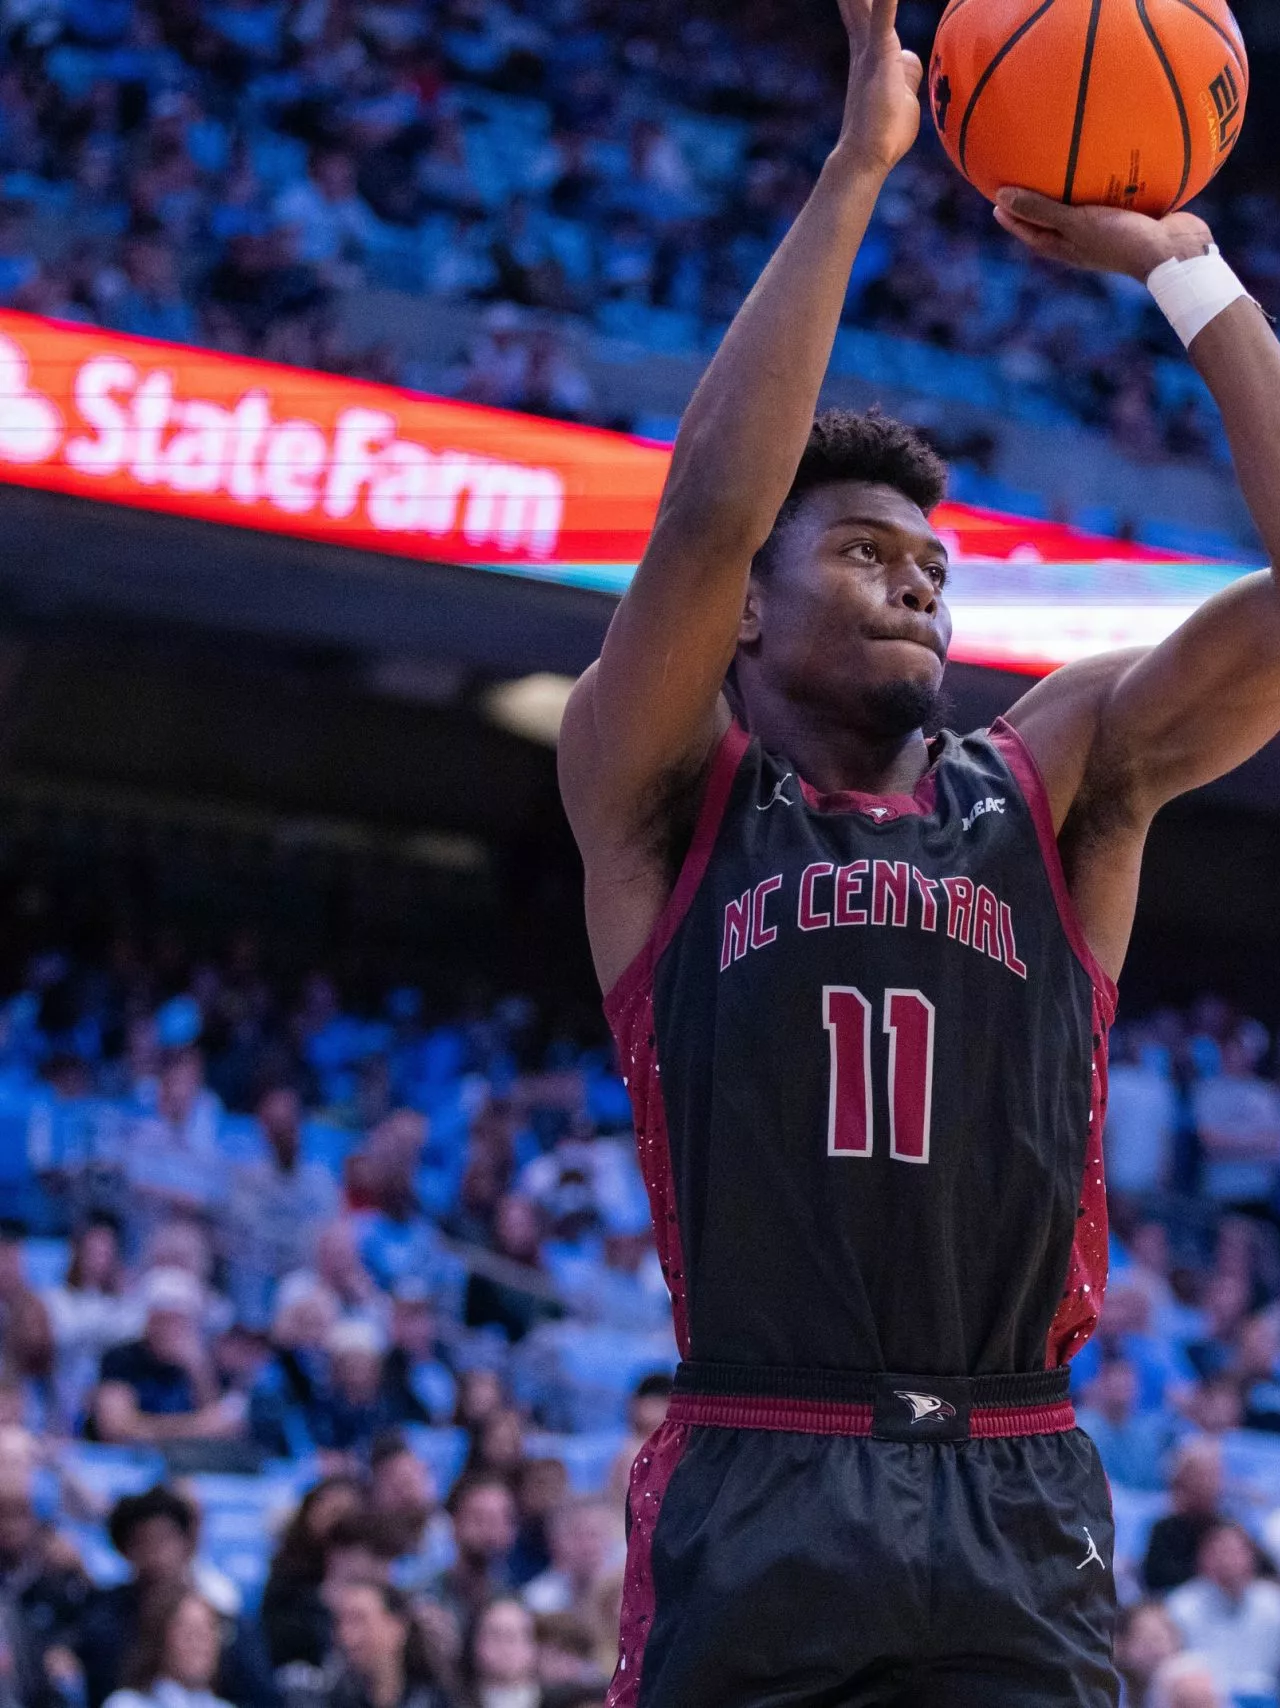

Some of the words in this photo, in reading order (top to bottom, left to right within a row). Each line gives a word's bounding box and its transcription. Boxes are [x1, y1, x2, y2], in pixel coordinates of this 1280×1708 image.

[961, 797, 1006, 832] MEAC
[720, 873, 783, 973] NC
[797, 859, 1027, 980] CENTRAL
[822, 985, 936, 1164] 11
